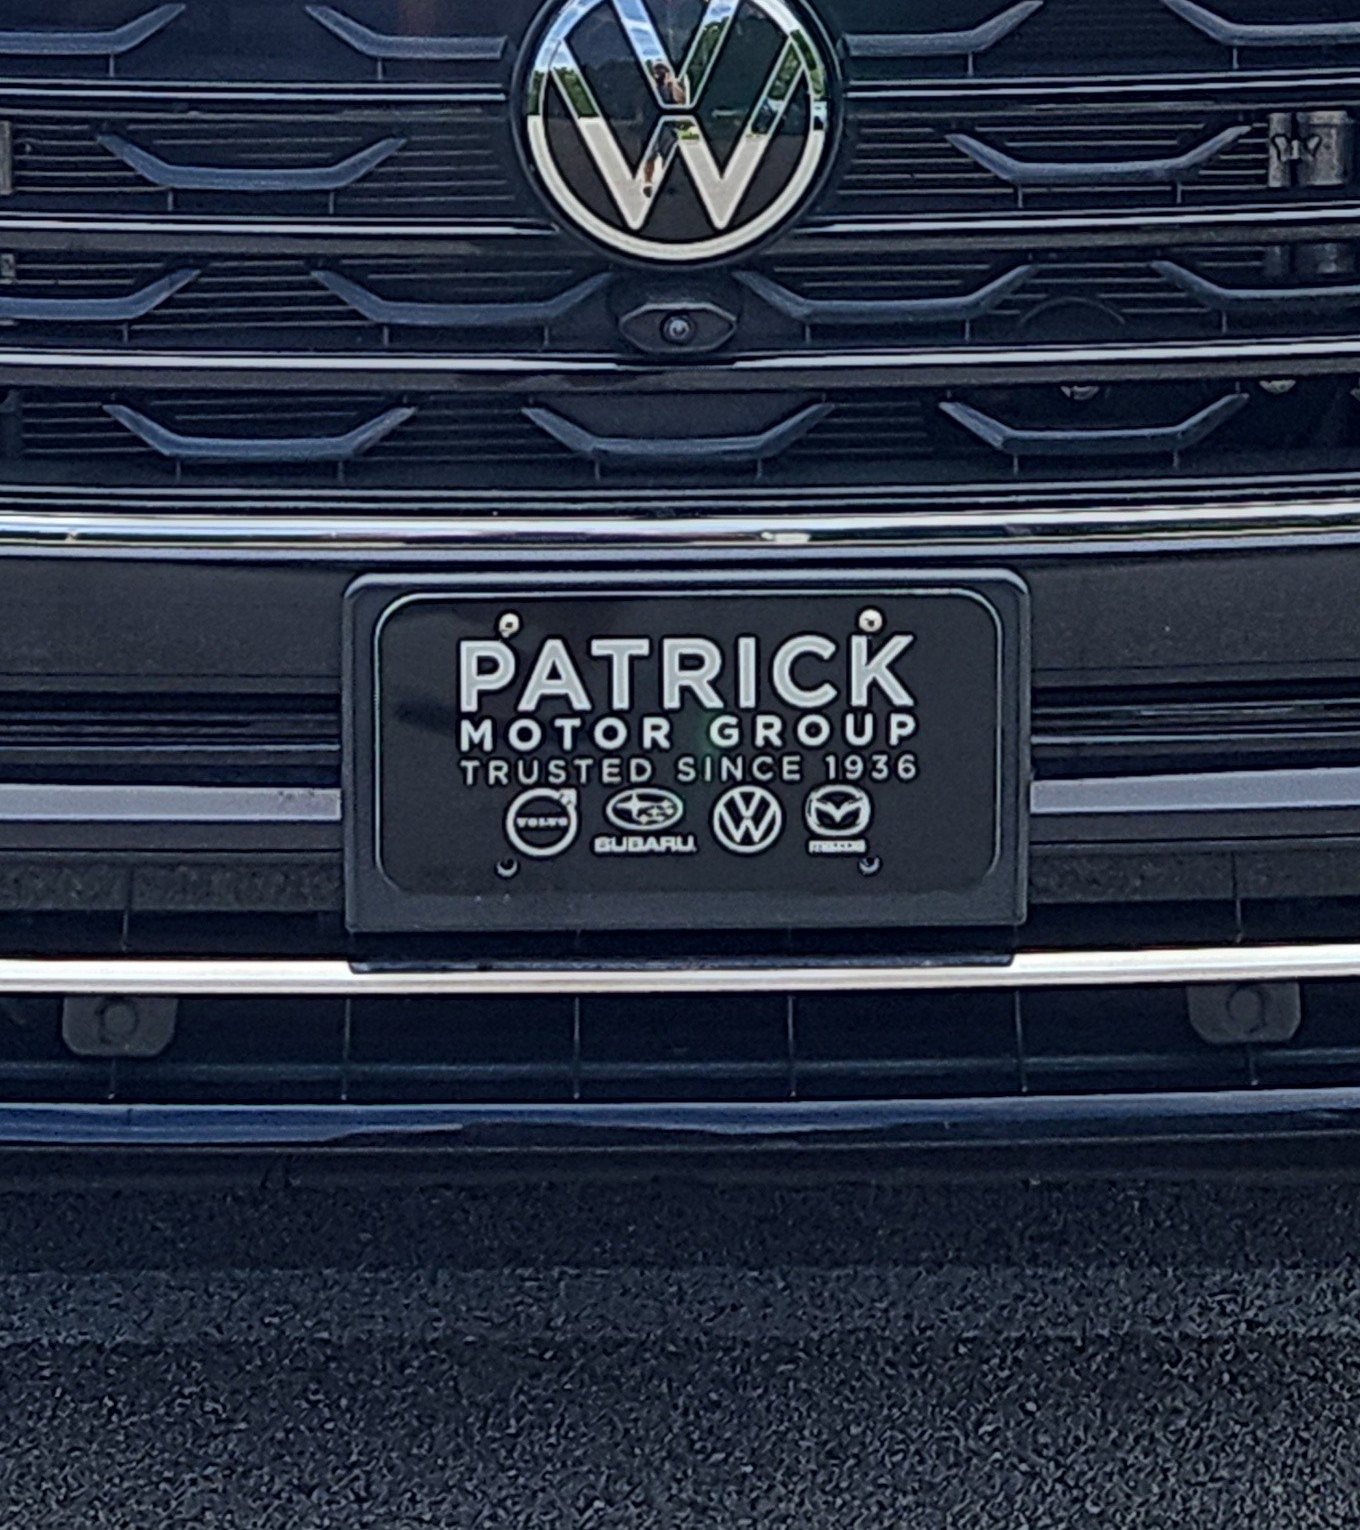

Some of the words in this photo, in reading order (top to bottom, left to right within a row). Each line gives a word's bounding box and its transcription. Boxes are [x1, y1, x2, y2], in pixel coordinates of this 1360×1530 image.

[459, 634, 916, 712] PATRICK
[459, 717, 671, 752] MOTOR
[709, 713, 917, 749] GROUP
[460, 758, 654, 786] TRUSTED
[677, 756, 803, 782] SINCE
[825, 753, 917, 780] 1936
